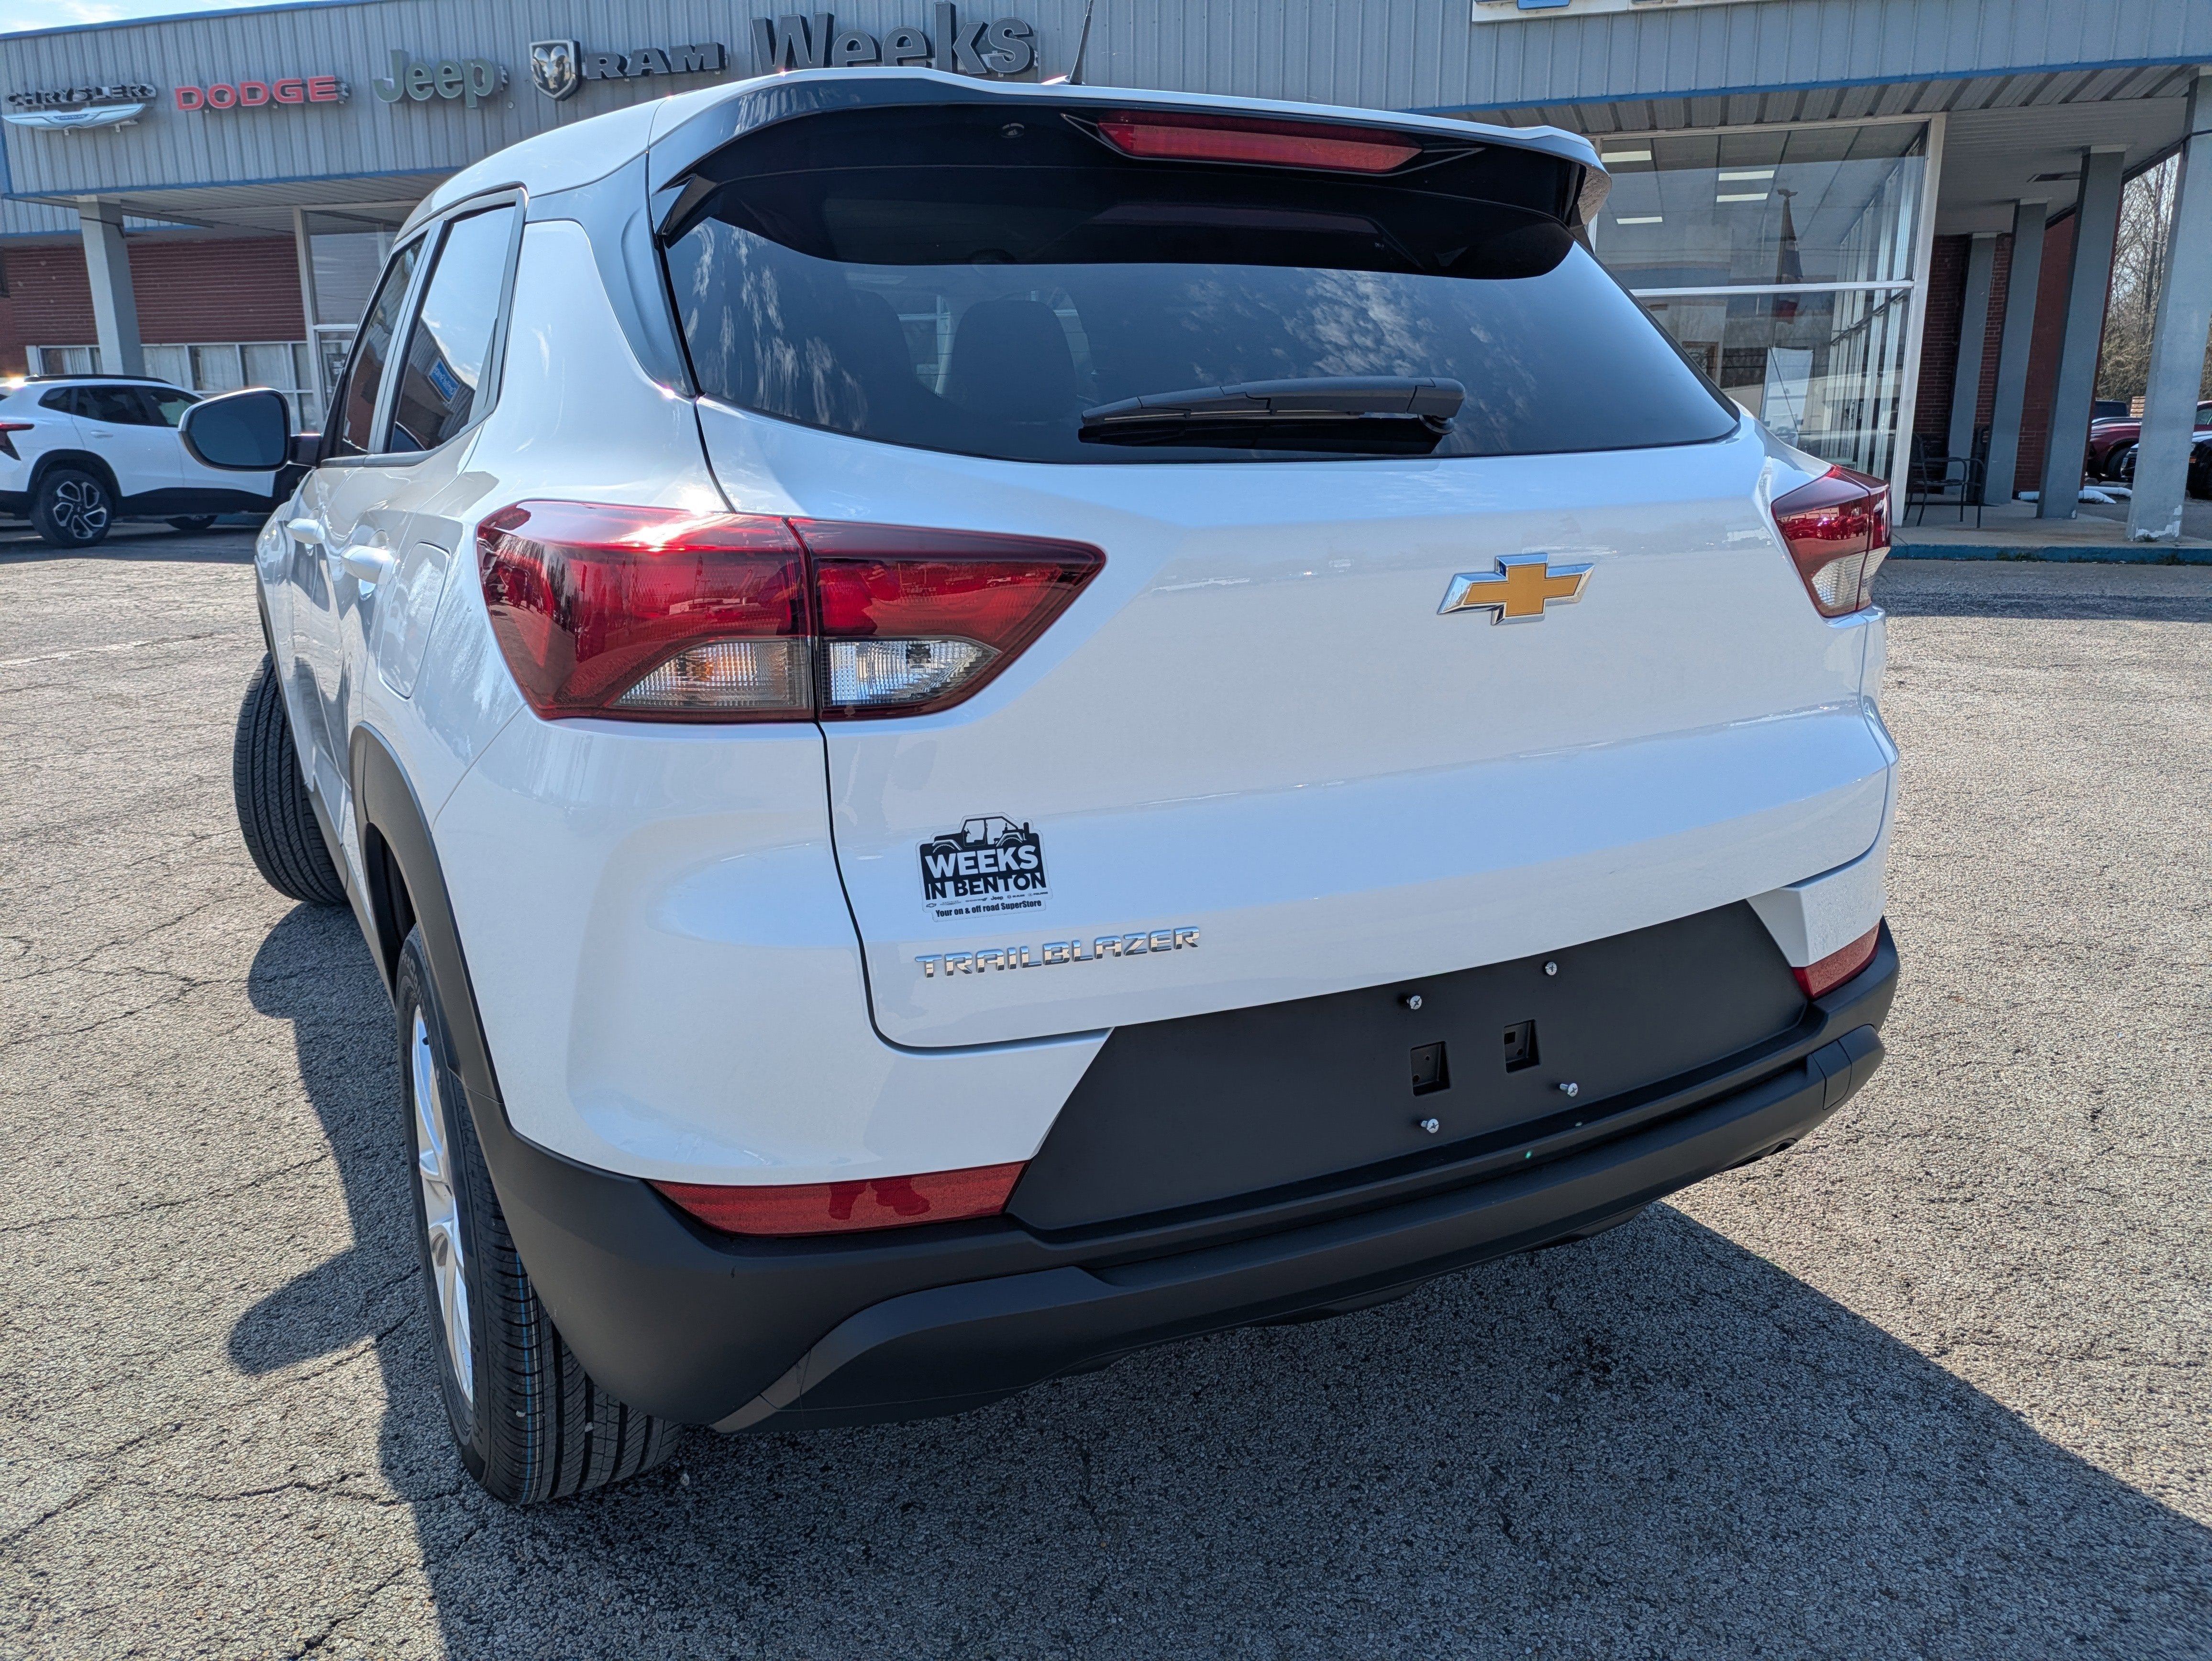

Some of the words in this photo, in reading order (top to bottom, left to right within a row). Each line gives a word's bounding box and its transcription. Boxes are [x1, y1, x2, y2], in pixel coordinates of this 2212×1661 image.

[750, 2, 1035, 75] Weeks
[373, 49, 496, 109] Jeep
[585, 42, 725, 80] RAM
[8, 83, 156, 105] CHRYSLER
[175, 75, 340, 111] DODGE
[924, 845, 1039, 878] WEEKS
[923, 880, 948, 900] IN
[953, 872, 1047, 897] BENTON
[935, 909, 952, 918] Your
[972, 904, 982, 913] off
[983, 903, 1000, 912] road
[1000, 900, 1042, 910] SuperStore
[915, 926, 1200, 978] TRAILBLAZER
